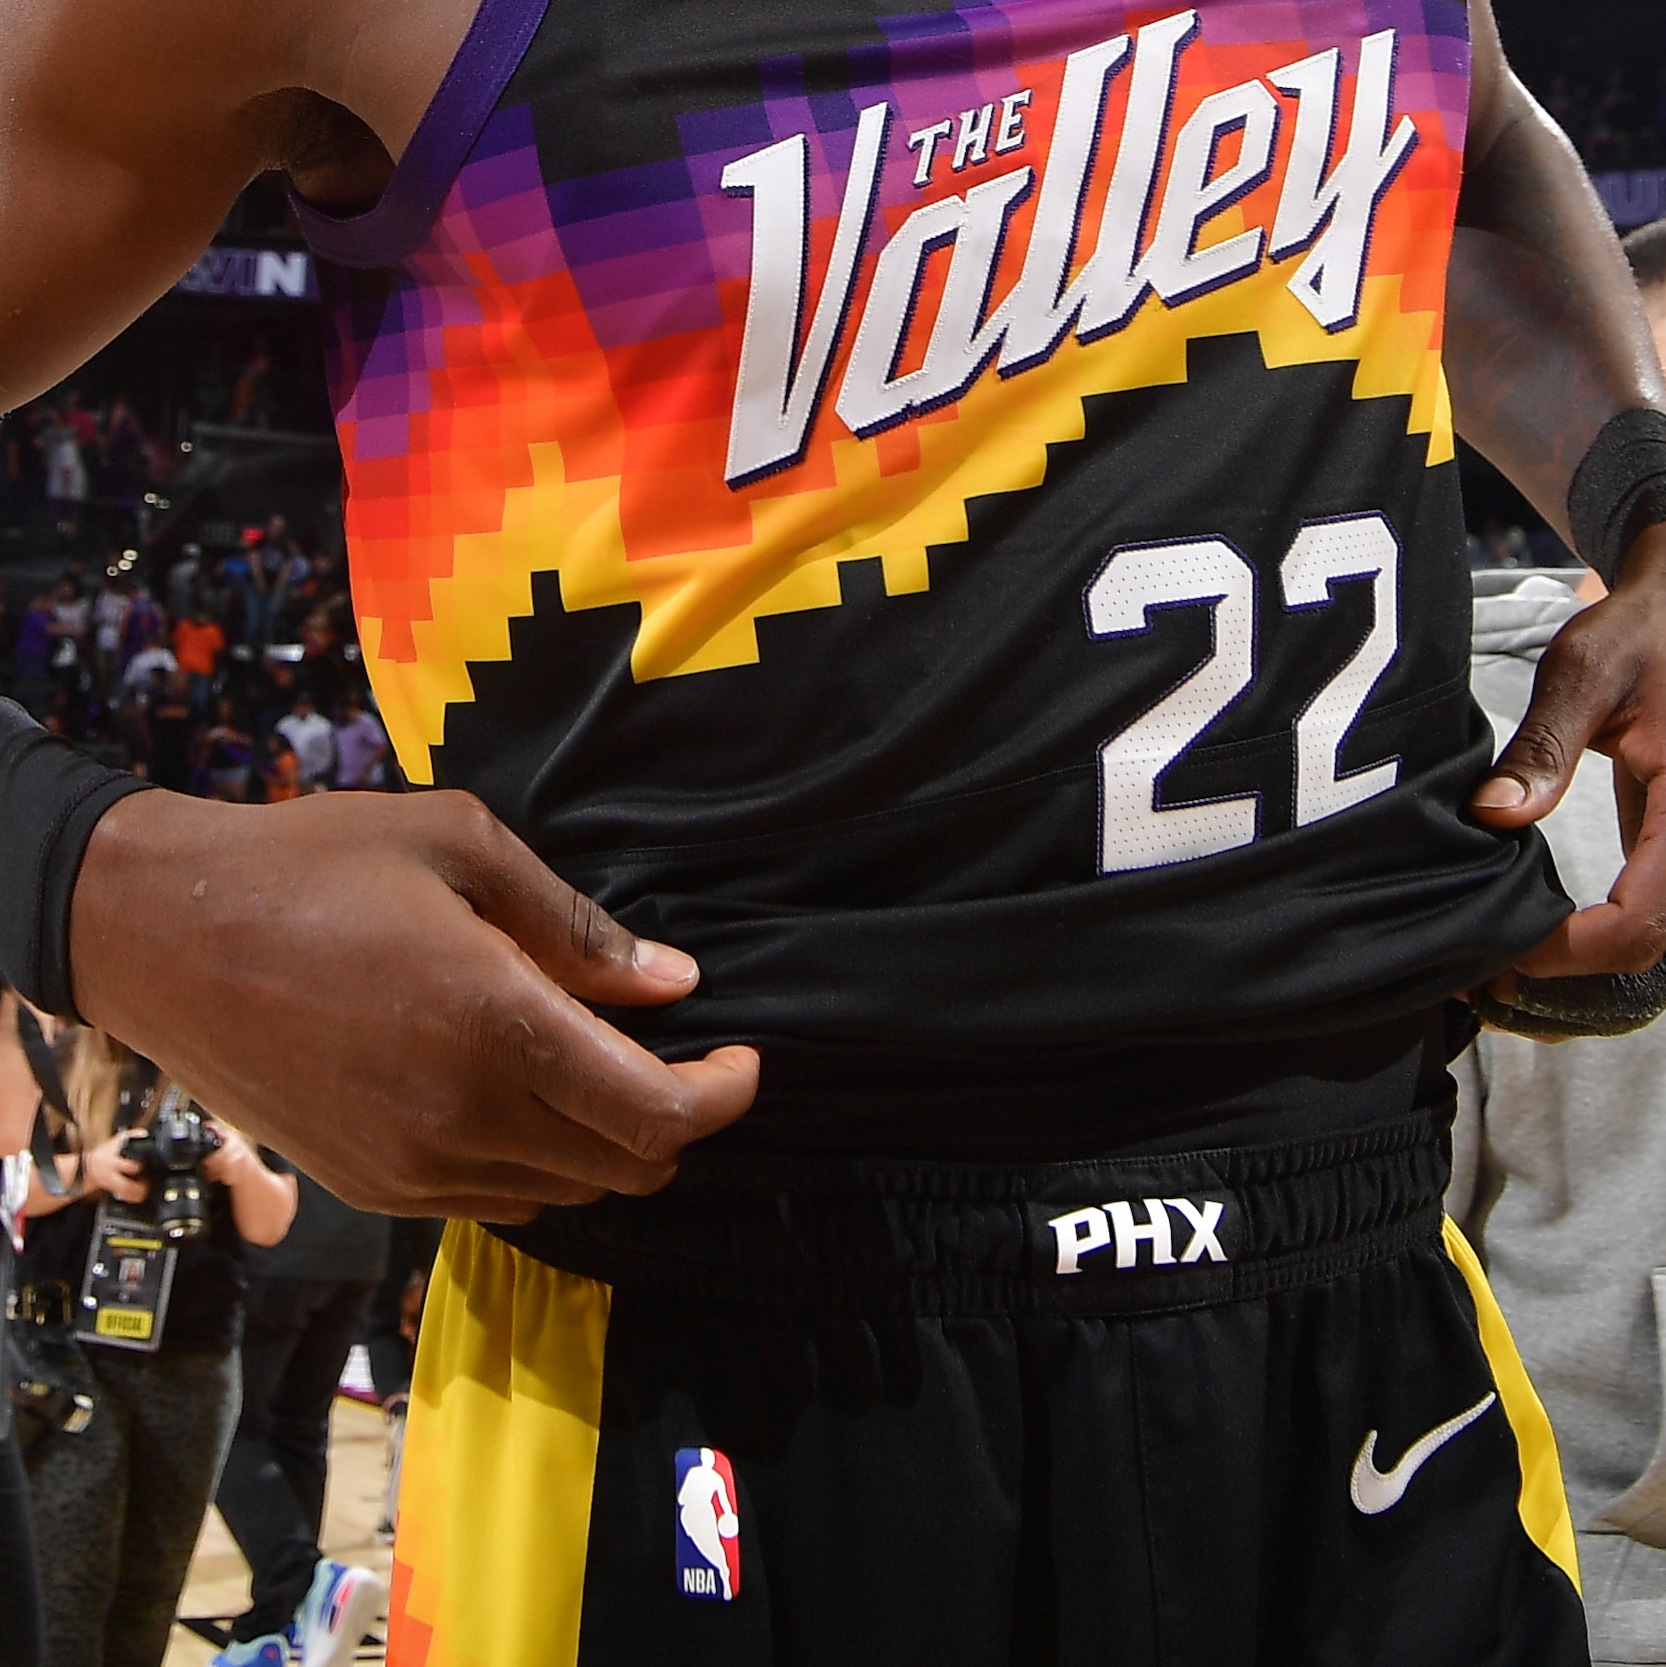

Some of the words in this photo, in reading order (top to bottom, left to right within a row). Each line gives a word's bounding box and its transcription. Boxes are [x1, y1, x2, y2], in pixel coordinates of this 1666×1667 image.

[907, 87, 1032, 186] THE
[720, 9, 1417, 494] Valley
[1082, 508, 1404, 879] 22
[1045, 1197, 1230, 1276] PHX
[683, 1567, 717, 1596] NBA
